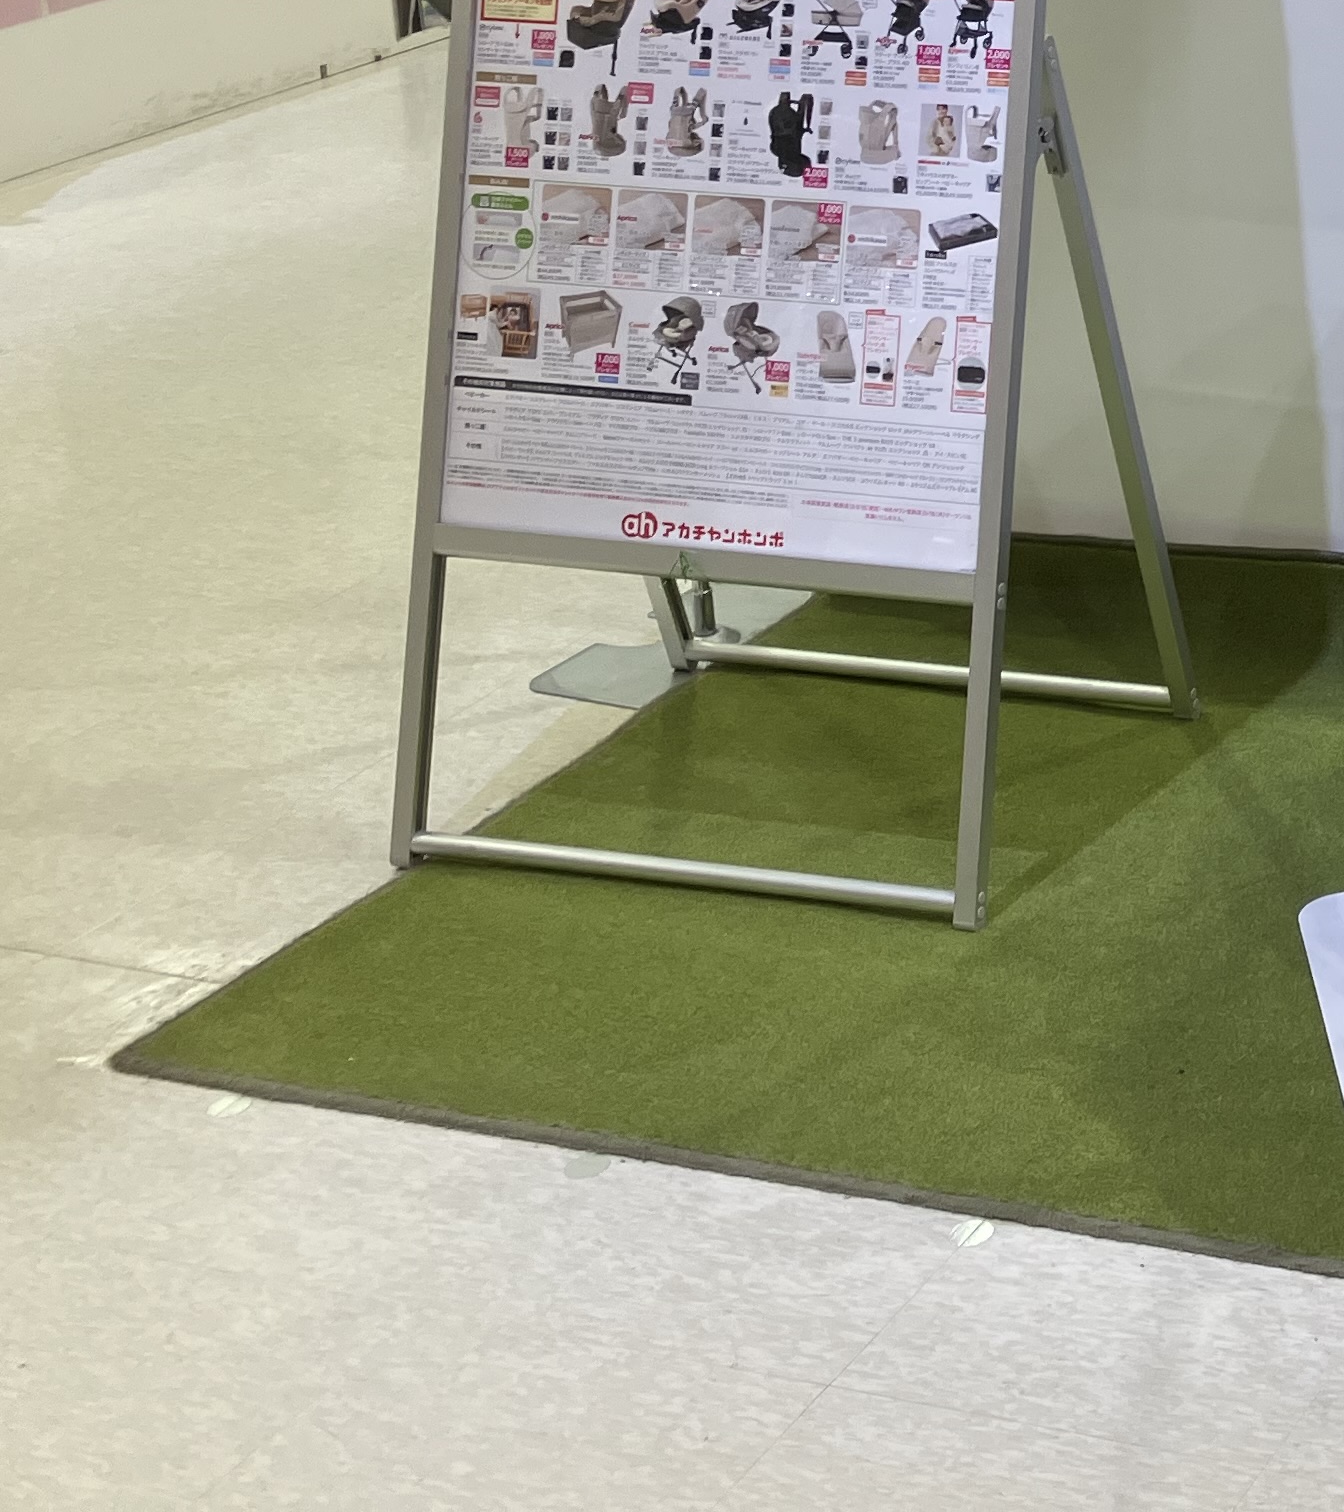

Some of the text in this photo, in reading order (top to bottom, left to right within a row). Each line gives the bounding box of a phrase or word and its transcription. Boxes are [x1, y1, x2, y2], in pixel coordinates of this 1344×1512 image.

[661, 520, 785, 548] アカチャンホンポ
